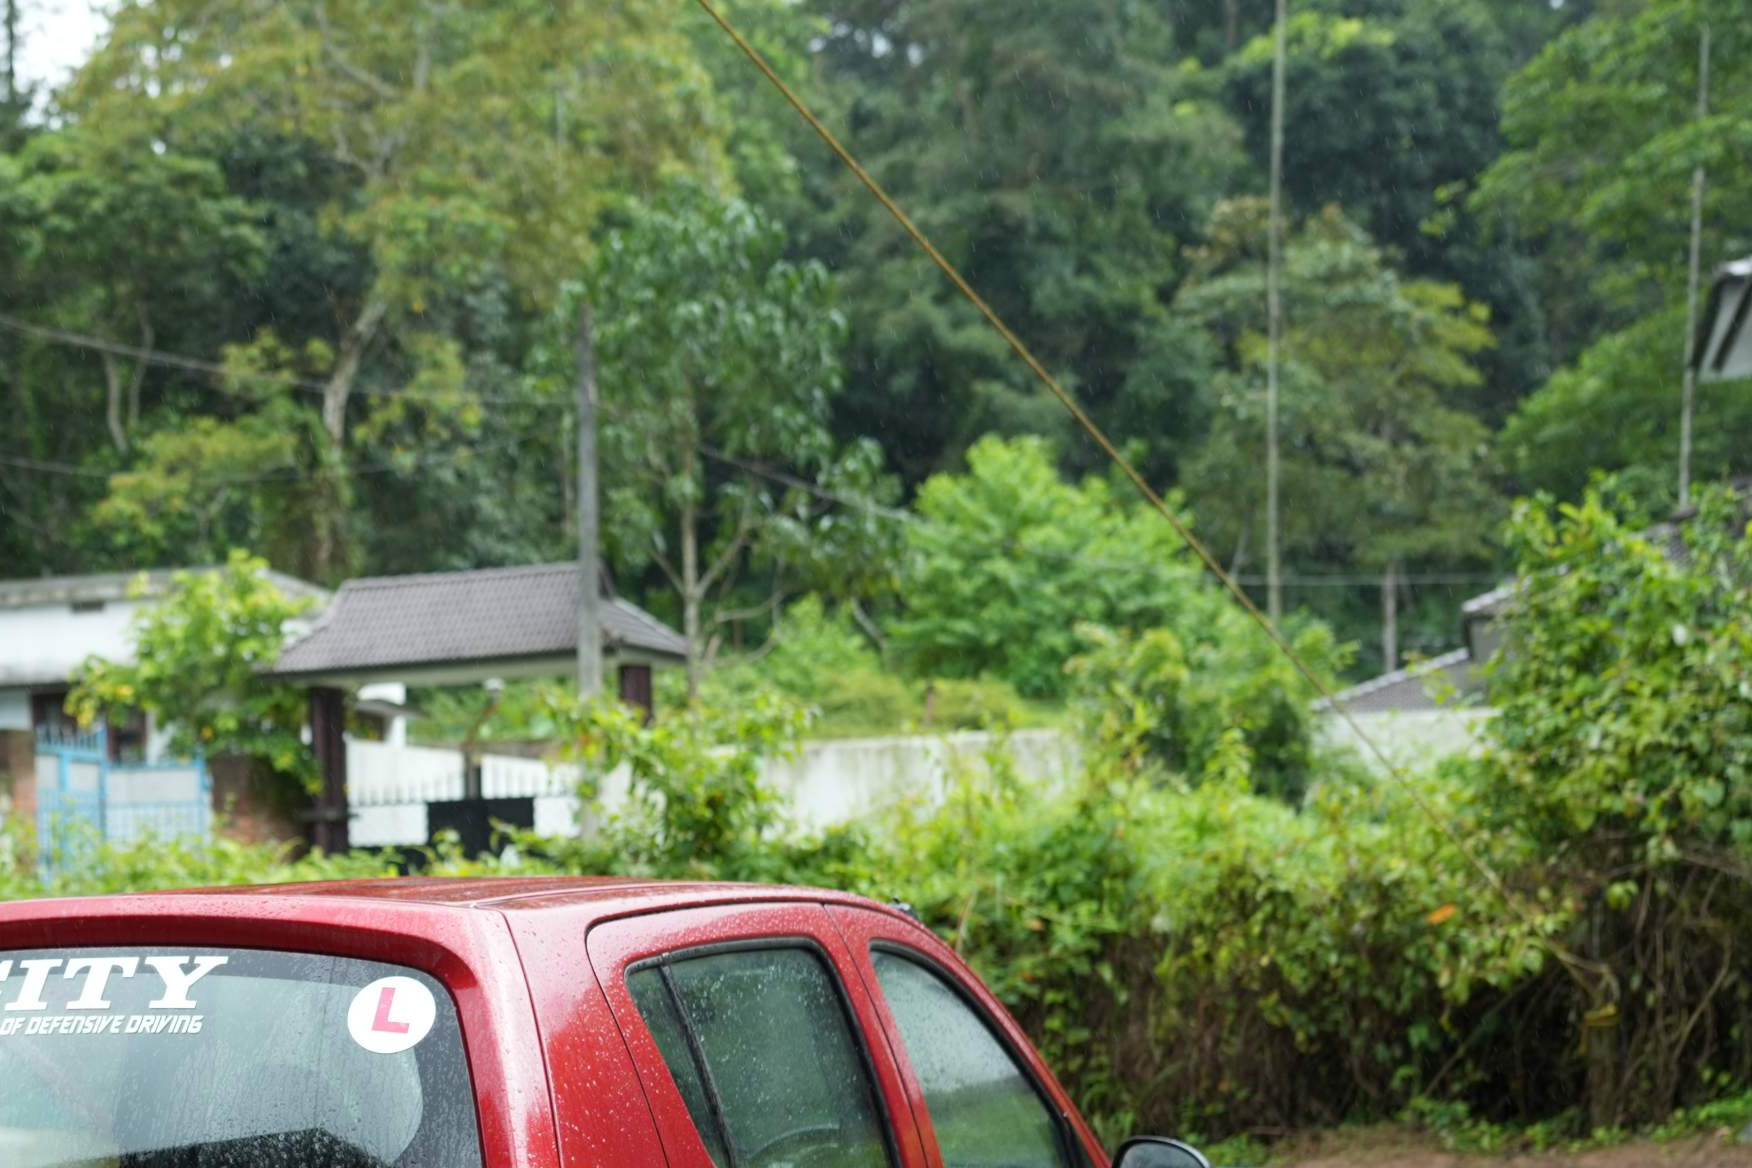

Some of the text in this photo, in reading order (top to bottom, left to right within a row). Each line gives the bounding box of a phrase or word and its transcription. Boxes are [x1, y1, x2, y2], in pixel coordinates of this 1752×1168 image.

[0, 1016, 25, 1036] OF
[25, 1015, 126, 1035] DEFENSIVE
[128, 1014, 204, 1035] DRIVING
[370, 986, 410, 1034] L
